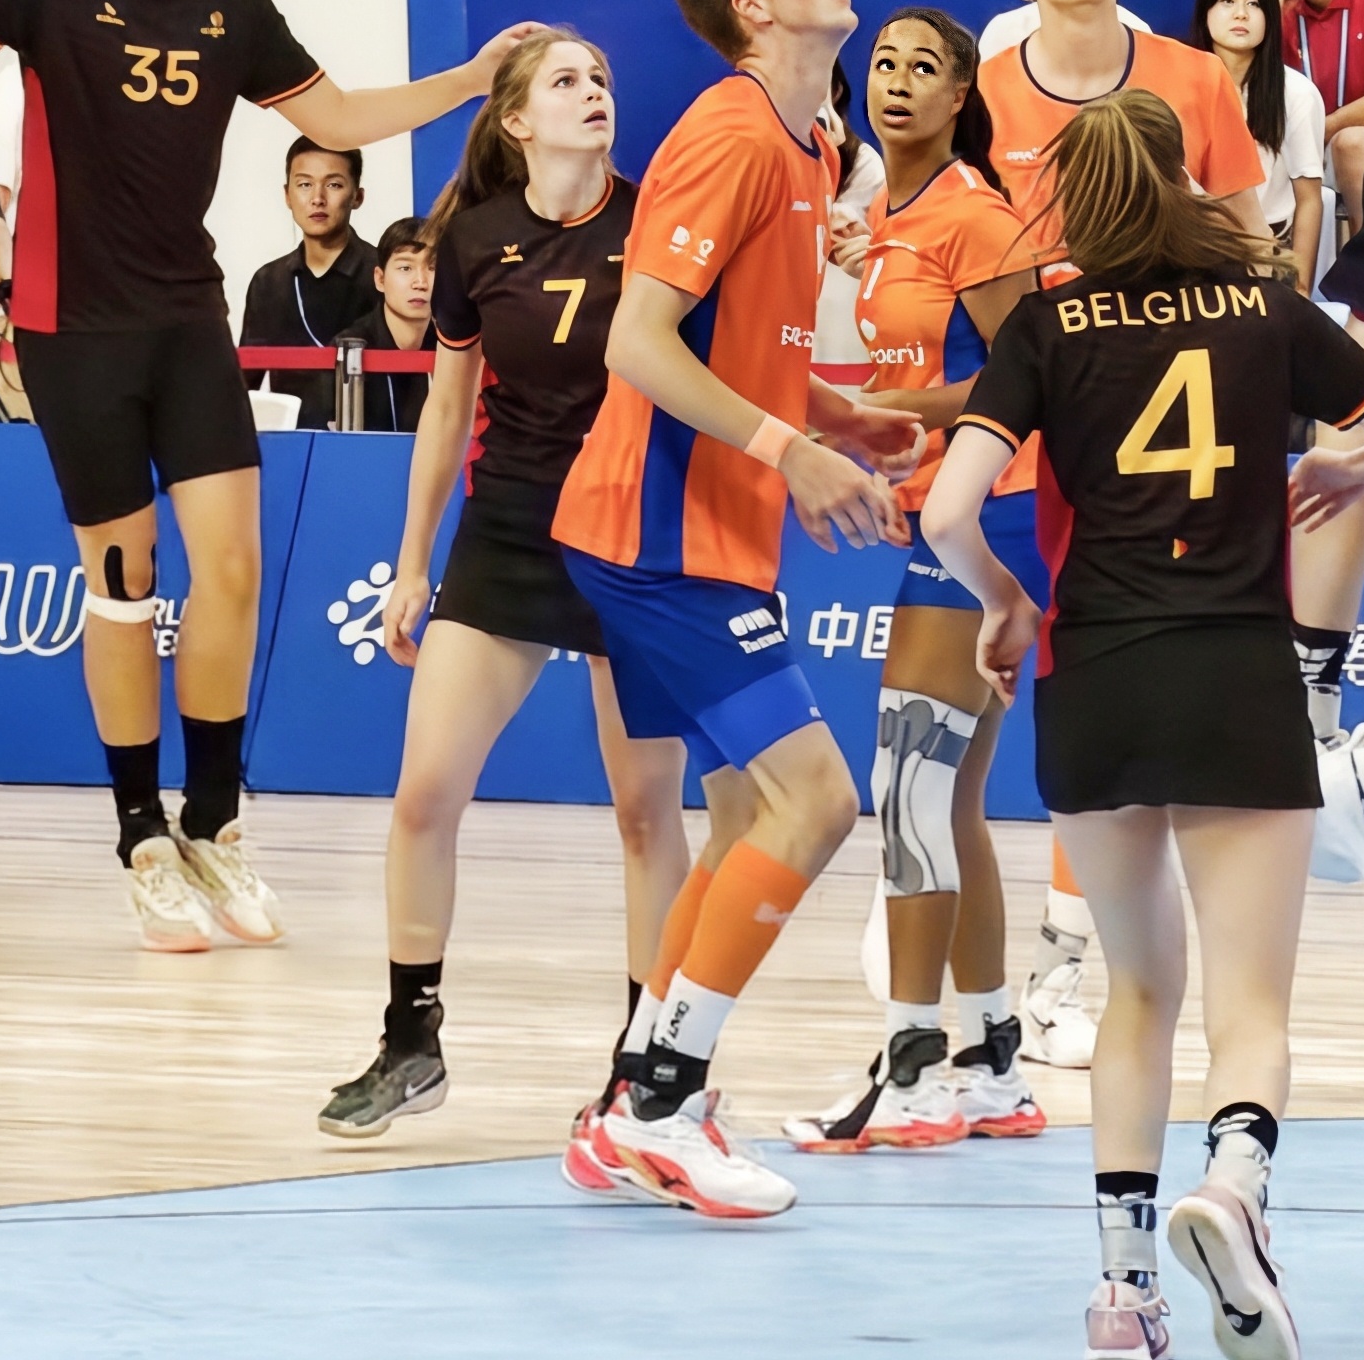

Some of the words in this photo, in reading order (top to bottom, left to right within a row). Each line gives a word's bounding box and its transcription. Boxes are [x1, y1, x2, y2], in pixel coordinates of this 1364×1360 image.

[121, 44, 201, 106] 35
[542, 278, 587, 344] 7
[1057, 284, 1267, 333] BELGIUM
[1115, 348, 1235, 500] 4
